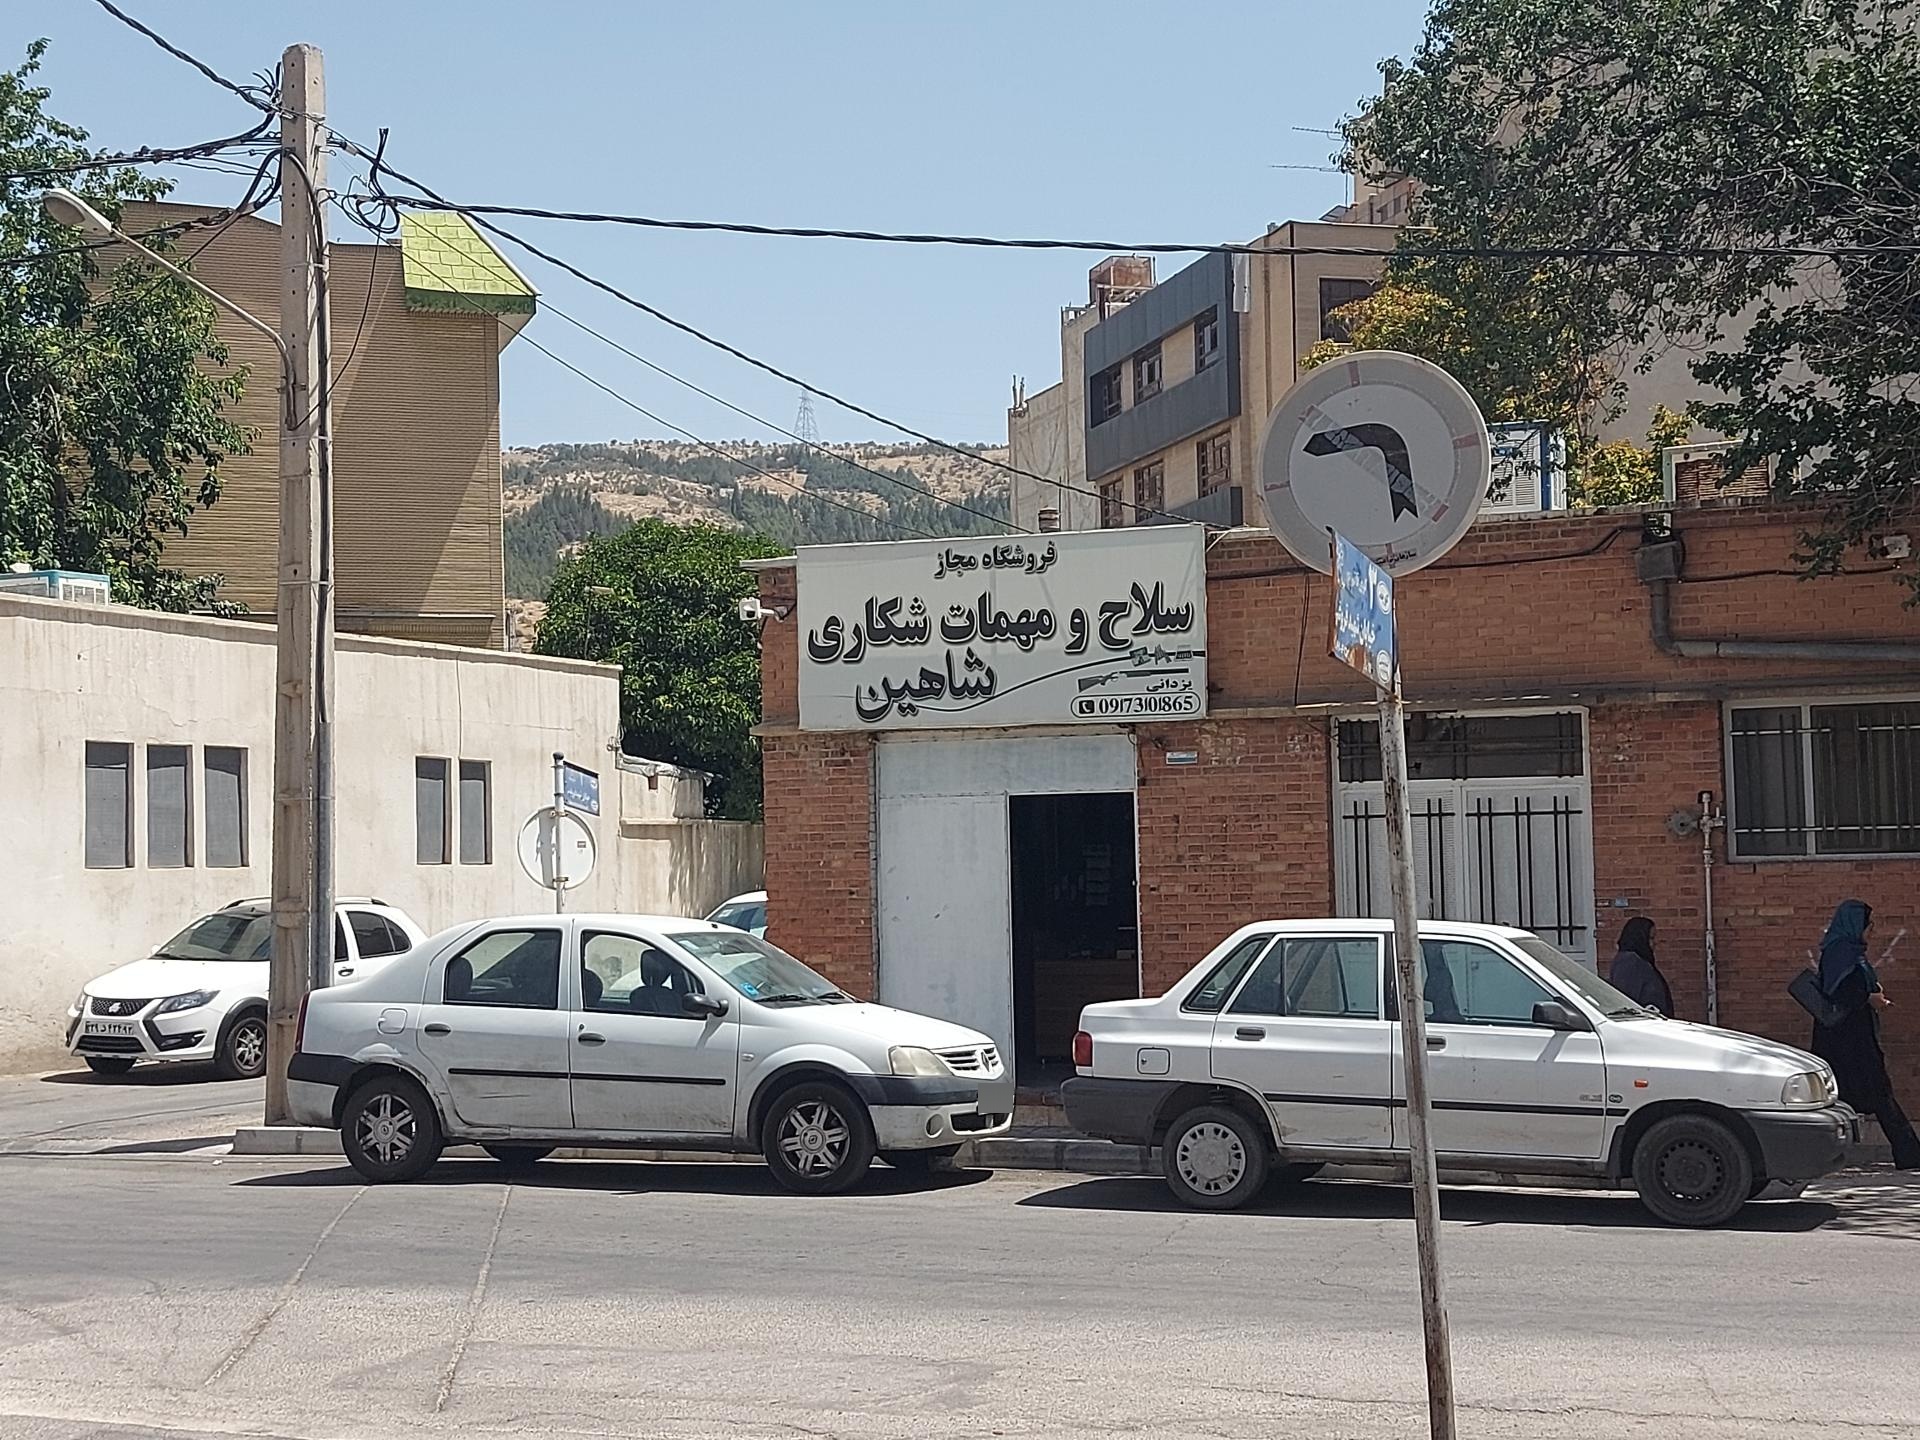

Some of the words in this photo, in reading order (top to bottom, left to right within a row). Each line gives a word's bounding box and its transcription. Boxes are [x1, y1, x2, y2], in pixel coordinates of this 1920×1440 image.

[934, 548, 977, 578] مجاز
[982, 541, 1057, 574] فروشگاه
[807, 595, 931, 664] شکاری
[940, 590, 1056, 650] مهمات
[1064, 607, 1089, 653] و
[1099, 580, 1193, 651] سلاح
[855, 646, 996, 722] شاهین
[1099, 695, 1194, 714] 09173101865
[1147, 678, 1193, 693] یزدانی
